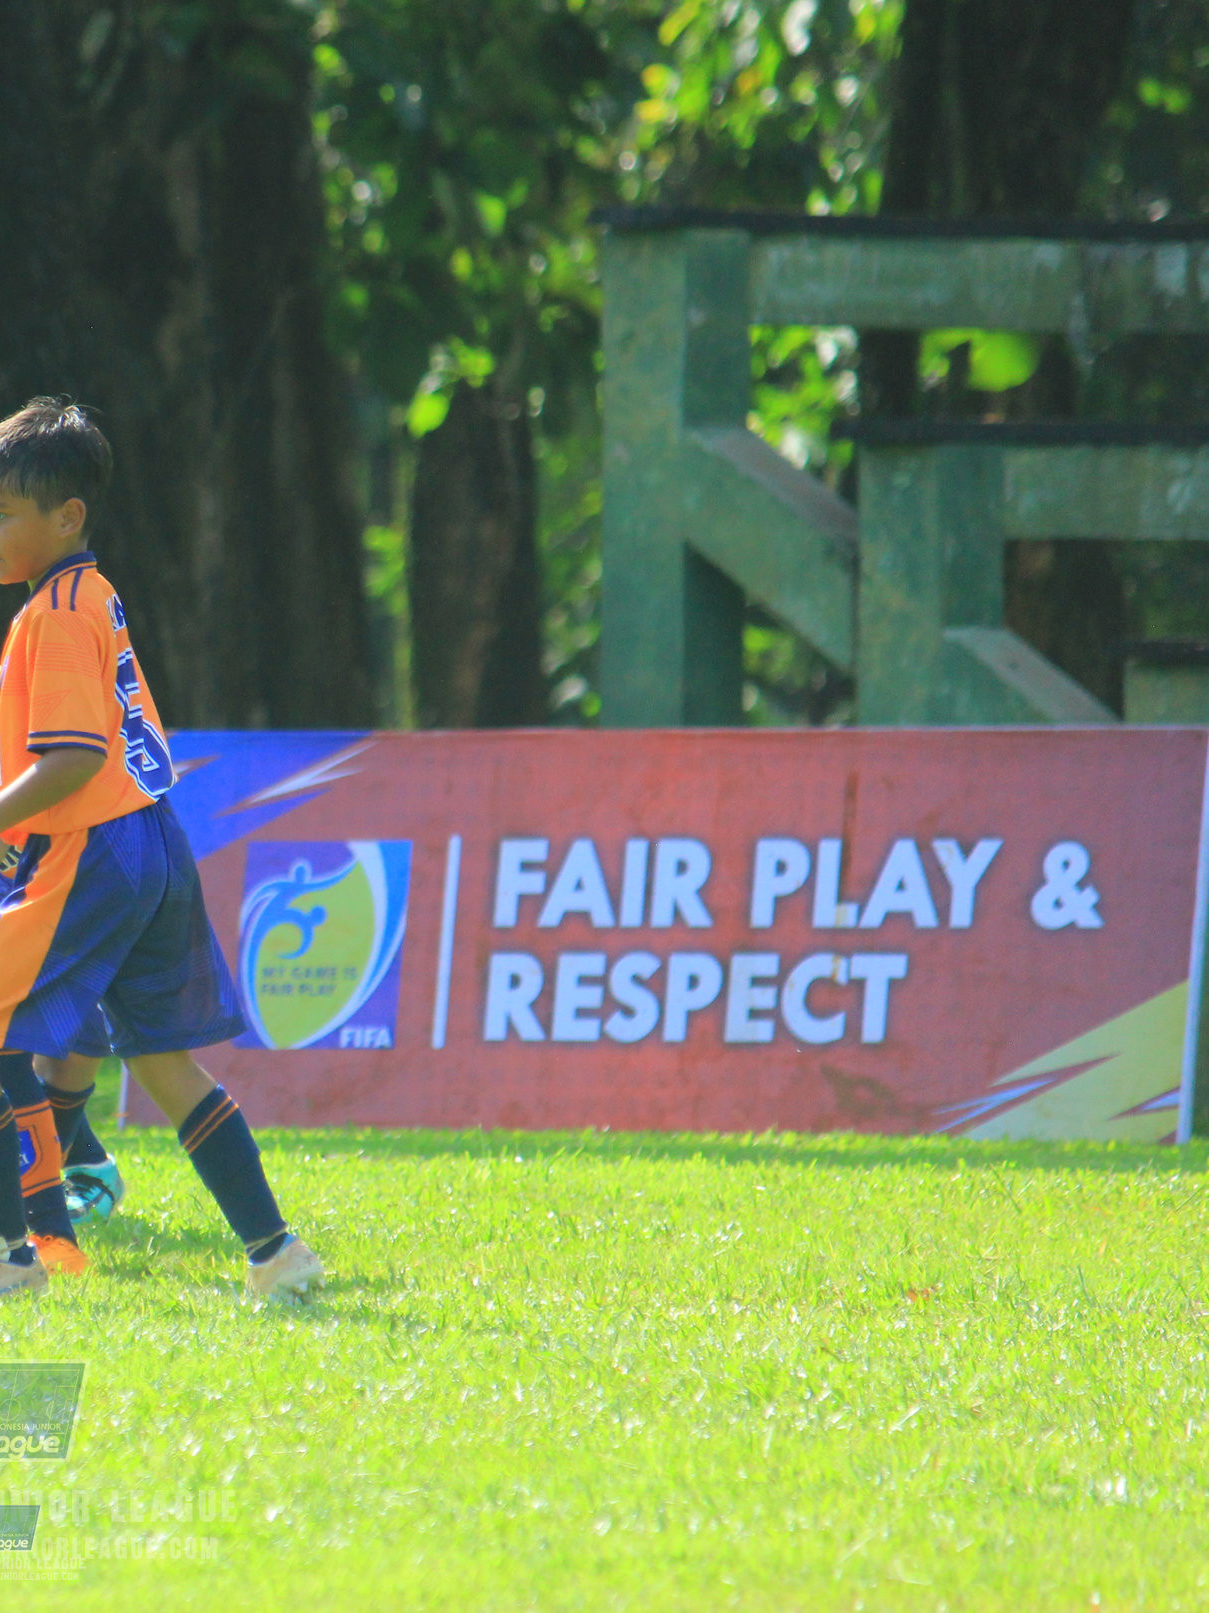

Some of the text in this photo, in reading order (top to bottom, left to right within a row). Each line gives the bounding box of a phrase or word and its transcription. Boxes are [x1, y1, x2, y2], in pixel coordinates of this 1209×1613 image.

[493, 837, 1105, 929] FAIR PLAY &
[340, 1027, 392, 1048] FIFA
[484, 952, 909, 1044] RESPECT
